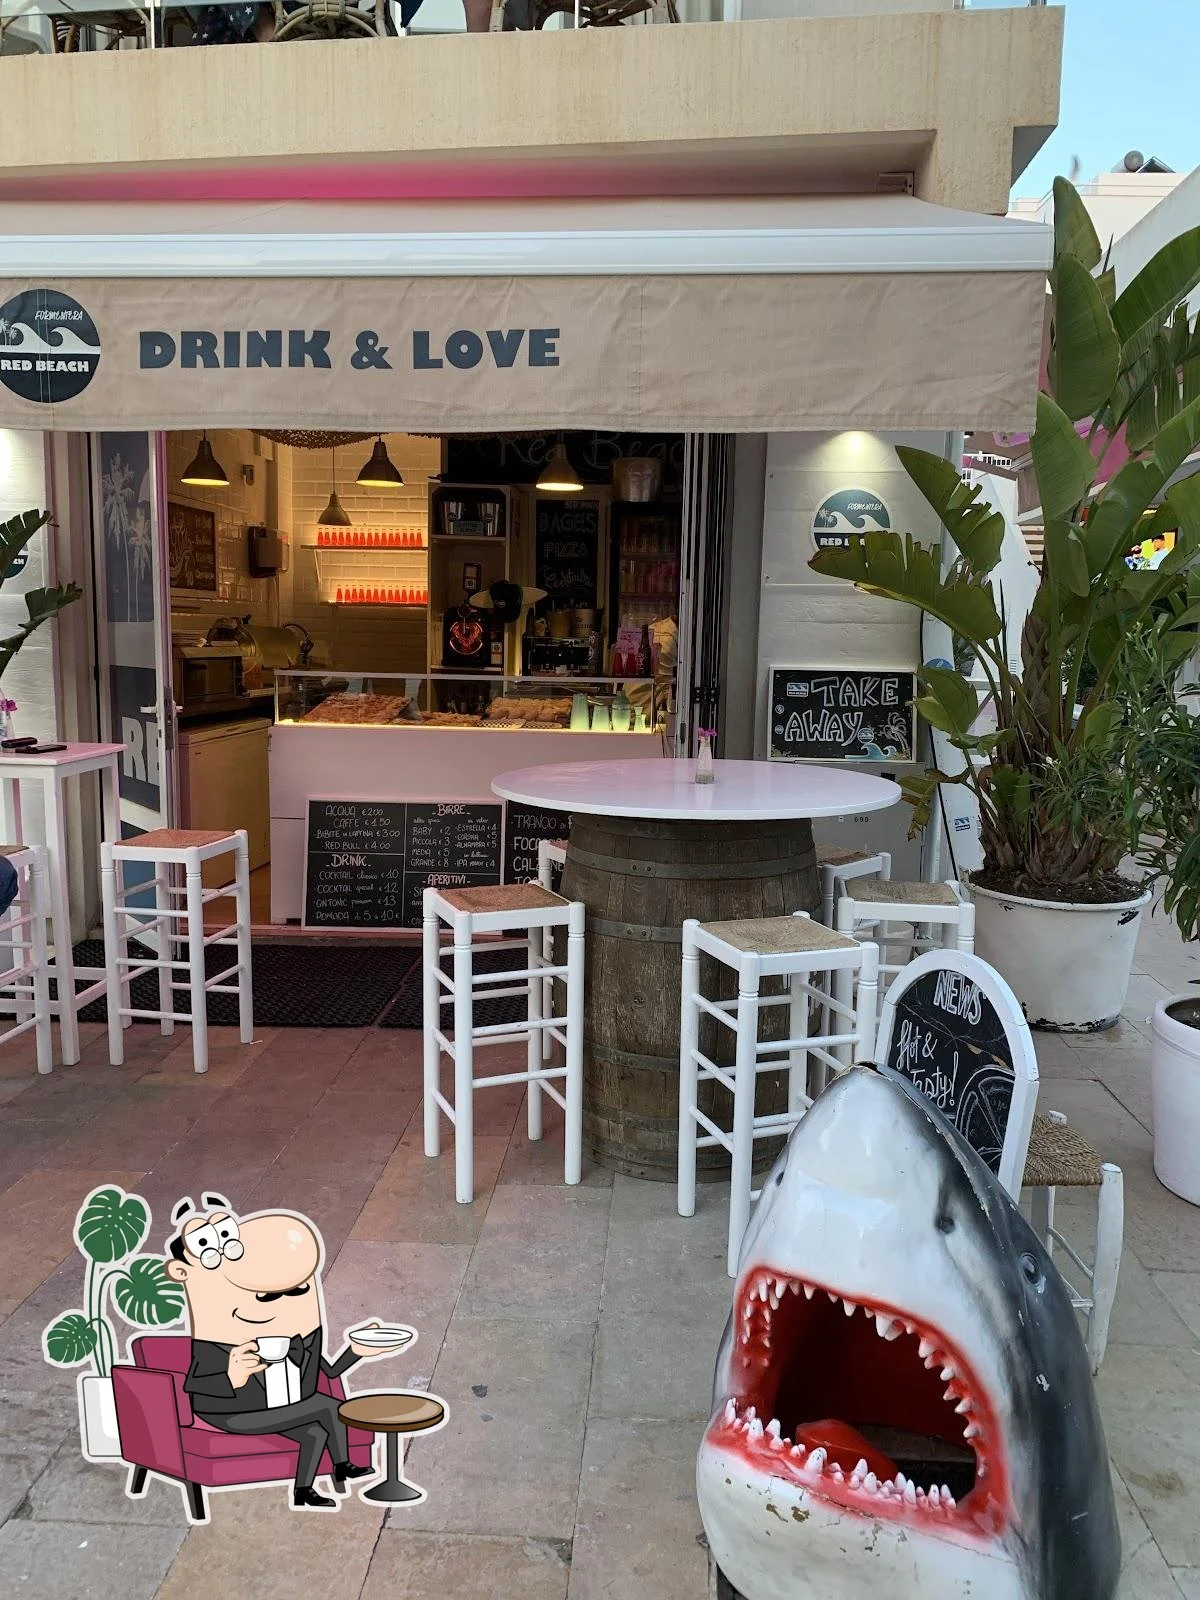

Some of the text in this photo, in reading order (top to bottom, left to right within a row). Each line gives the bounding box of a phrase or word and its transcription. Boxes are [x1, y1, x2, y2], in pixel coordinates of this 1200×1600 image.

[35, 310, 83, 321] FORMENTERA
[139, 328, 561, 370] DRINK & LOVE
[0, 360, 90, 372] RED BEACH
[820, 538, 843, 546] RED
[810, 676, 899, 707] TAKE
[784, 709, 863, 746] AWAY
[325, 804, 356, 818] ACQUA
[436, 804, 467, 817] BIRRE
[324, 841, 341, 850] RED
[342, 841, 361, 851] BULL
[330, 853, 368, 868] DRINK
[319, 870, 353, 881] COCKTAIL
[427, 873, 467, 886] APERITIVI
[317, 884, 352, 894] COCKTAIL
[933, 970, 987, 1026] NEWS
[896, 1019, 938, 1072] Hot &
